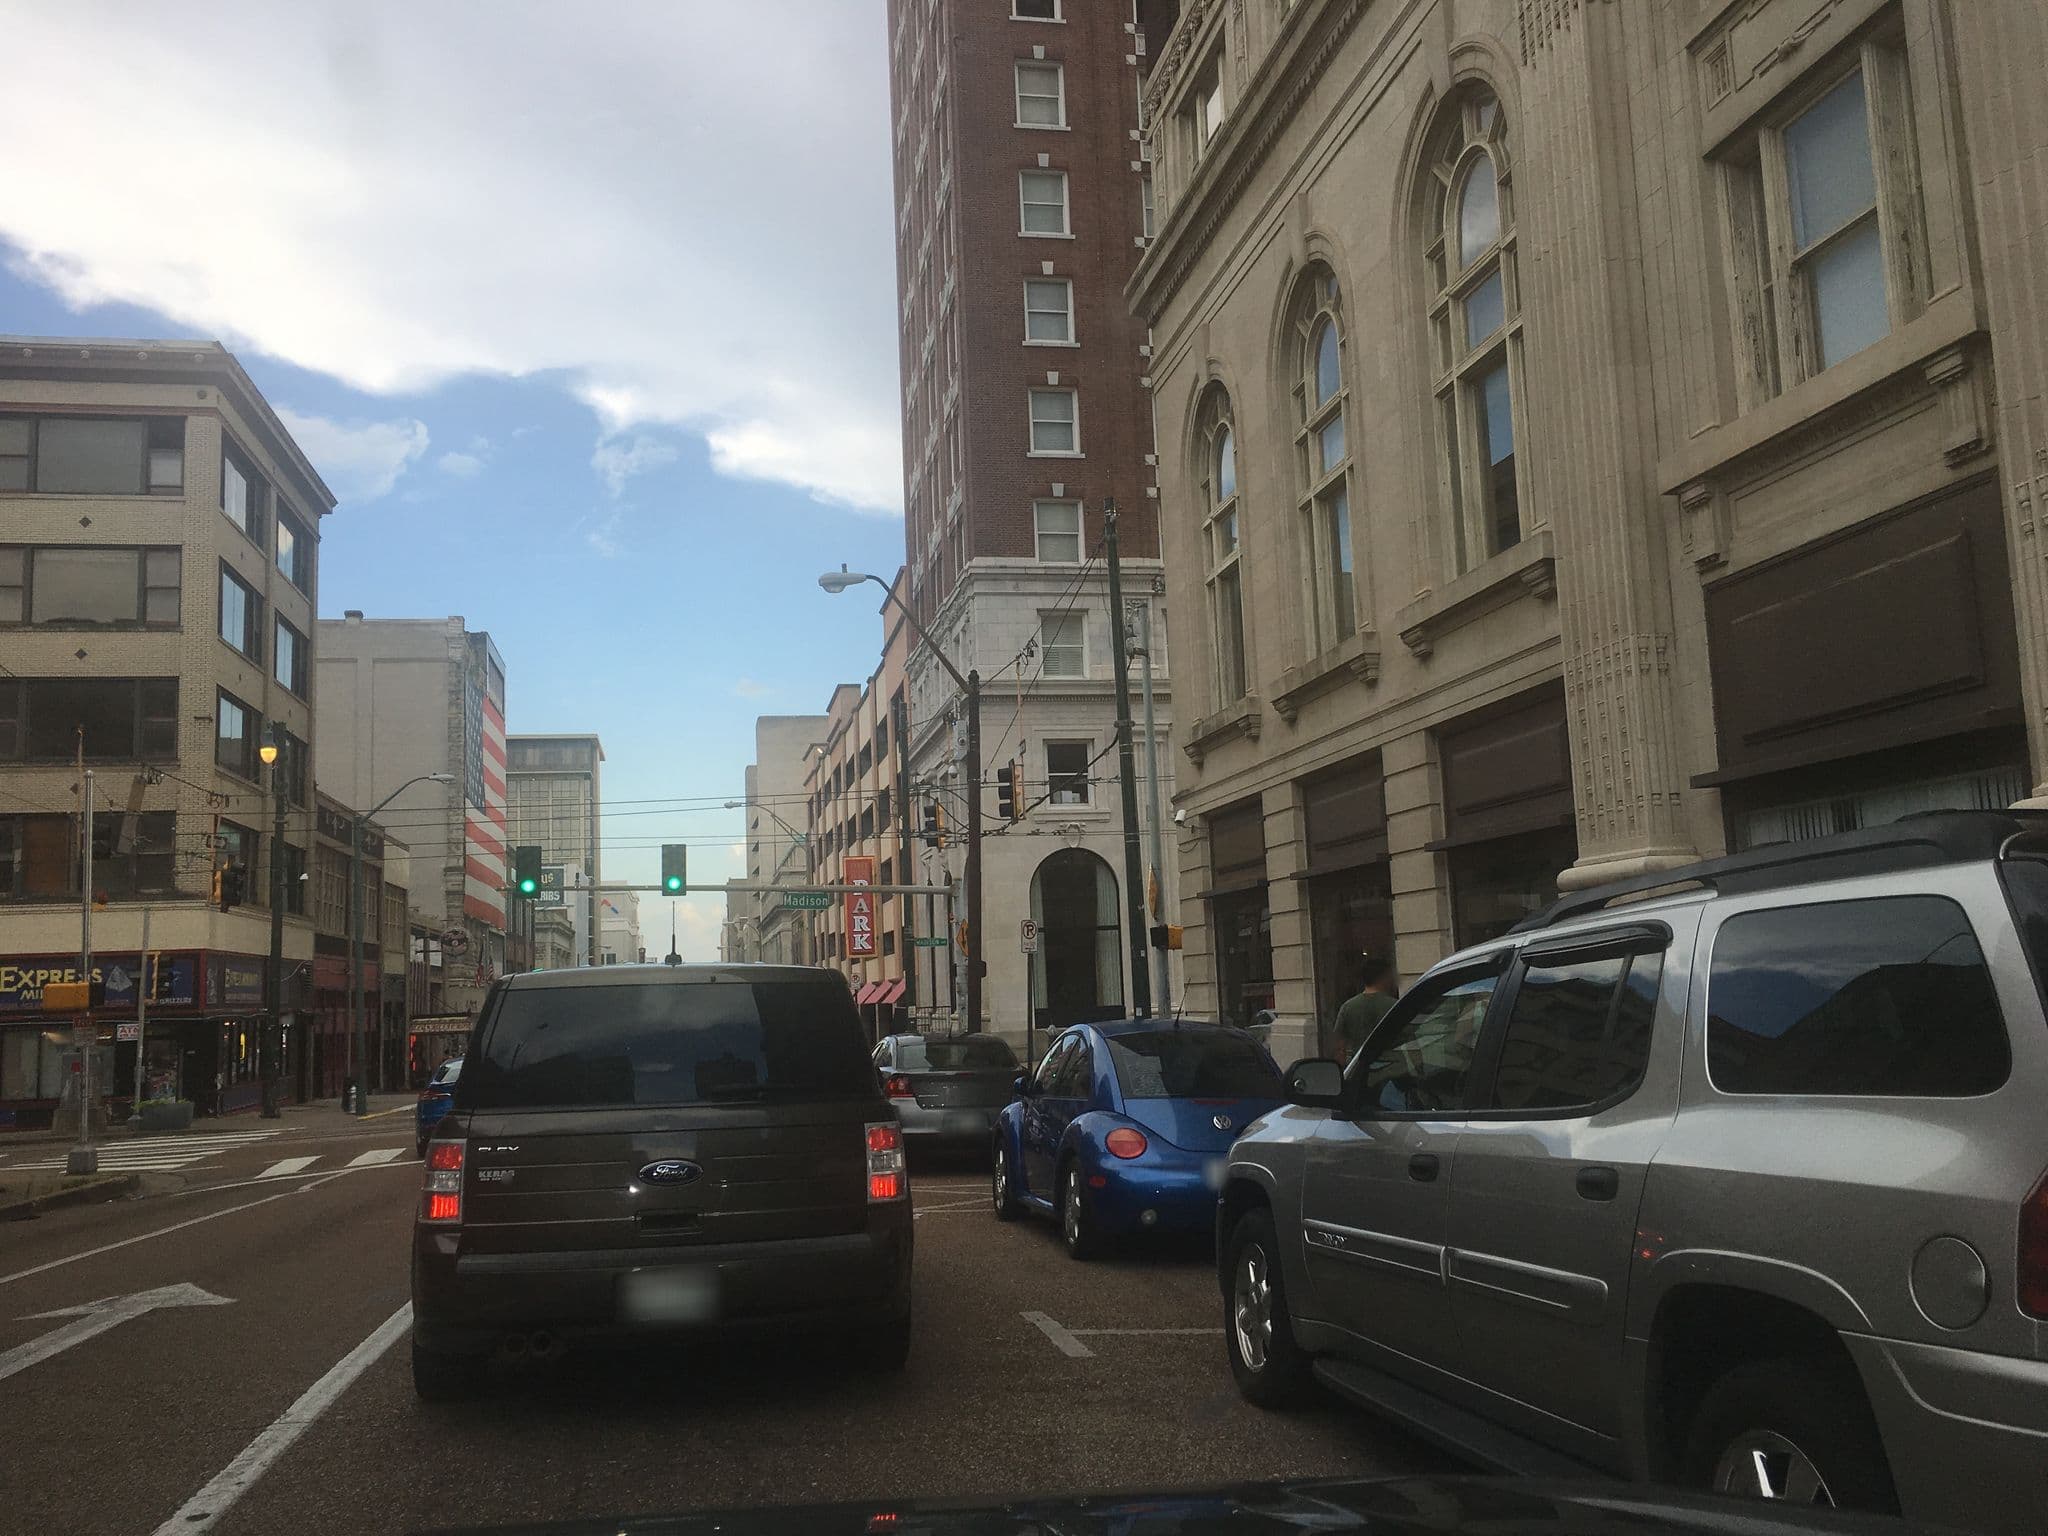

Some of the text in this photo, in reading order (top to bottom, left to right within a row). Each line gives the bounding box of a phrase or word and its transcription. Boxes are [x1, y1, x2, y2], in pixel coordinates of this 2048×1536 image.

[783, 894, 829, 906] Madison
[852, 879, 872, 950] PARK
[0, 966, 103, 993] EXPRES
[652, 1164, 688, 1177] Ford
